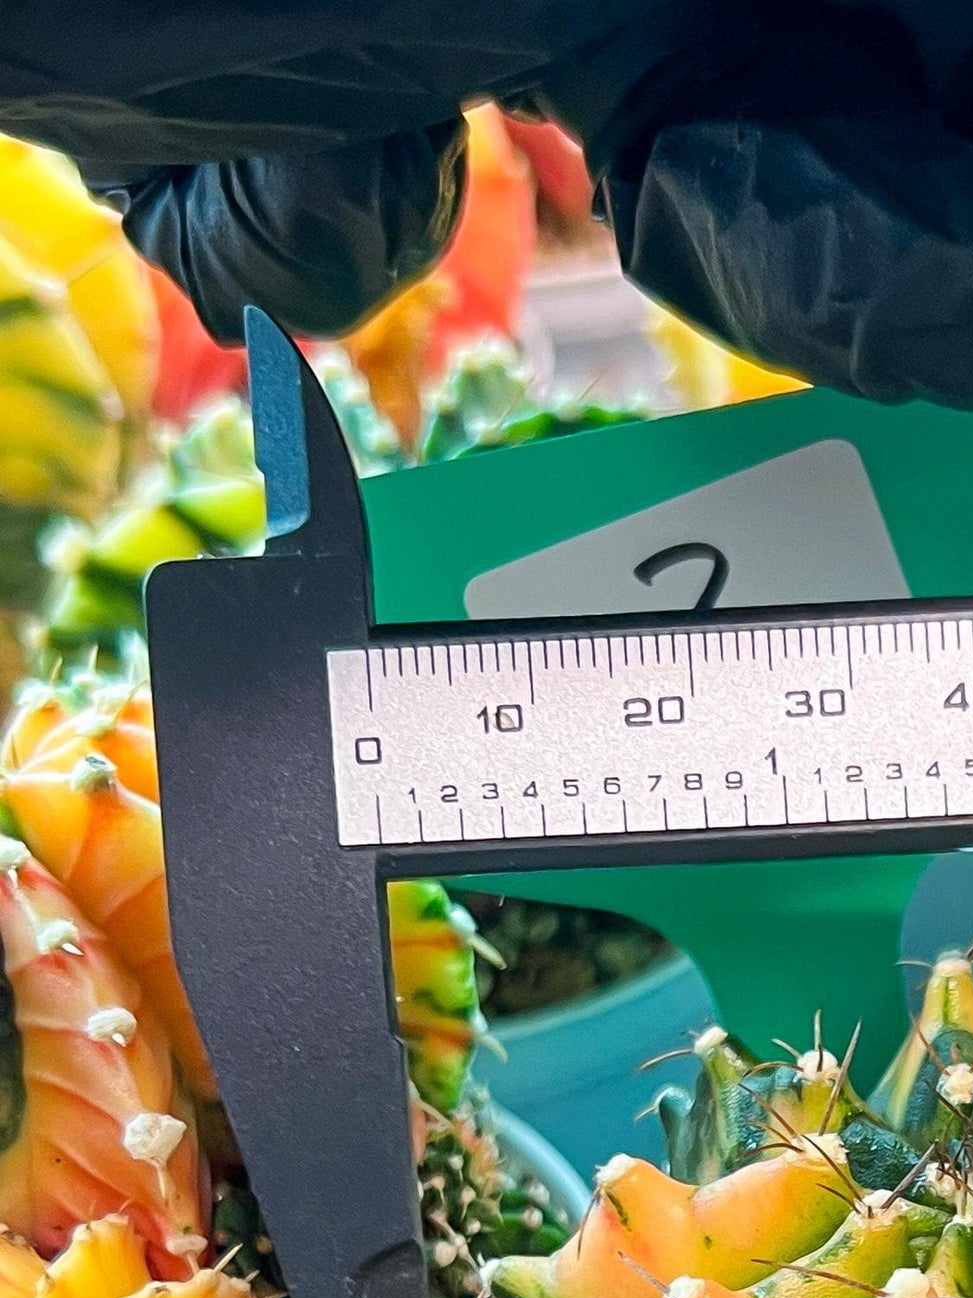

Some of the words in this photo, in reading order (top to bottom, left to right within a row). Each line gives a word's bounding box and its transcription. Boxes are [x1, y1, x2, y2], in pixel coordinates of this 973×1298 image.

[475, 703, 524, 735] 10
[622, 695, 685, 728] 20
[784, 688, 846, 718] 30
[439, 784, 459, 804] 2
[481, 782, 500, 800] 3
[522, 780, 539, 799] 4
[562, 778, 580, 798] 5
[603, 776, 622, 795] 6
[647, 774, 663, 793] 7
[683, 772, 704, 791] 8
[724, 770, 744, 790] 9
[764, 746, 778, 776] 1
[844, 764, 864, 783] 2
[885, 762, 904, 781] 3
[925, 760, 941, 779] 4
